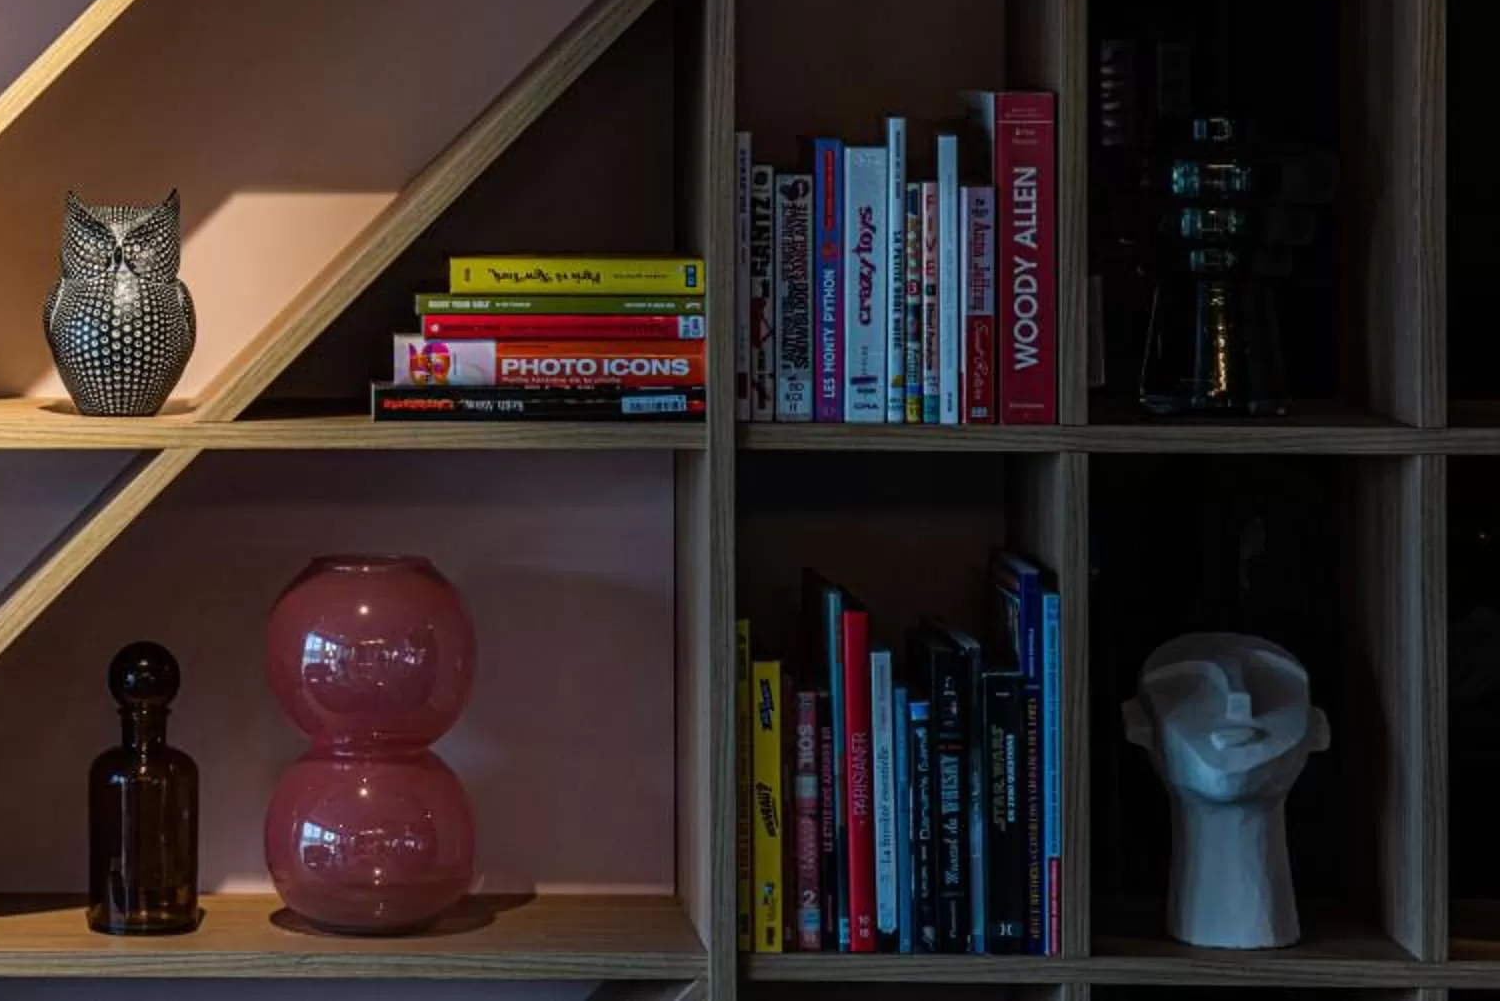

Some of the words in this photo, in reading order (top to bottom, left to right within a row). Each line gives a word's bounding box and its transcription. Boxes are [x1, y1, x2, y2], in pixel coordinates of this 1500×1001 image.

[852, 206, 874, 253] toys
[1012, 166, 1038, 249] ALLEN
[823, 270, 836, 322] PYTHON
[856, 258, 876, 326] crazy
[1013, 254, 1039, 371] WOODY
[501, 358, 597, 376] PHOTO
[603, 358, 690, 376] ICONS
[823, 328, 836, 372] MONTY
[823, 378, 835, 398] LES
[991, 723, 1005, 775] WARS
[940, 754, 959, 814] WHISKY
